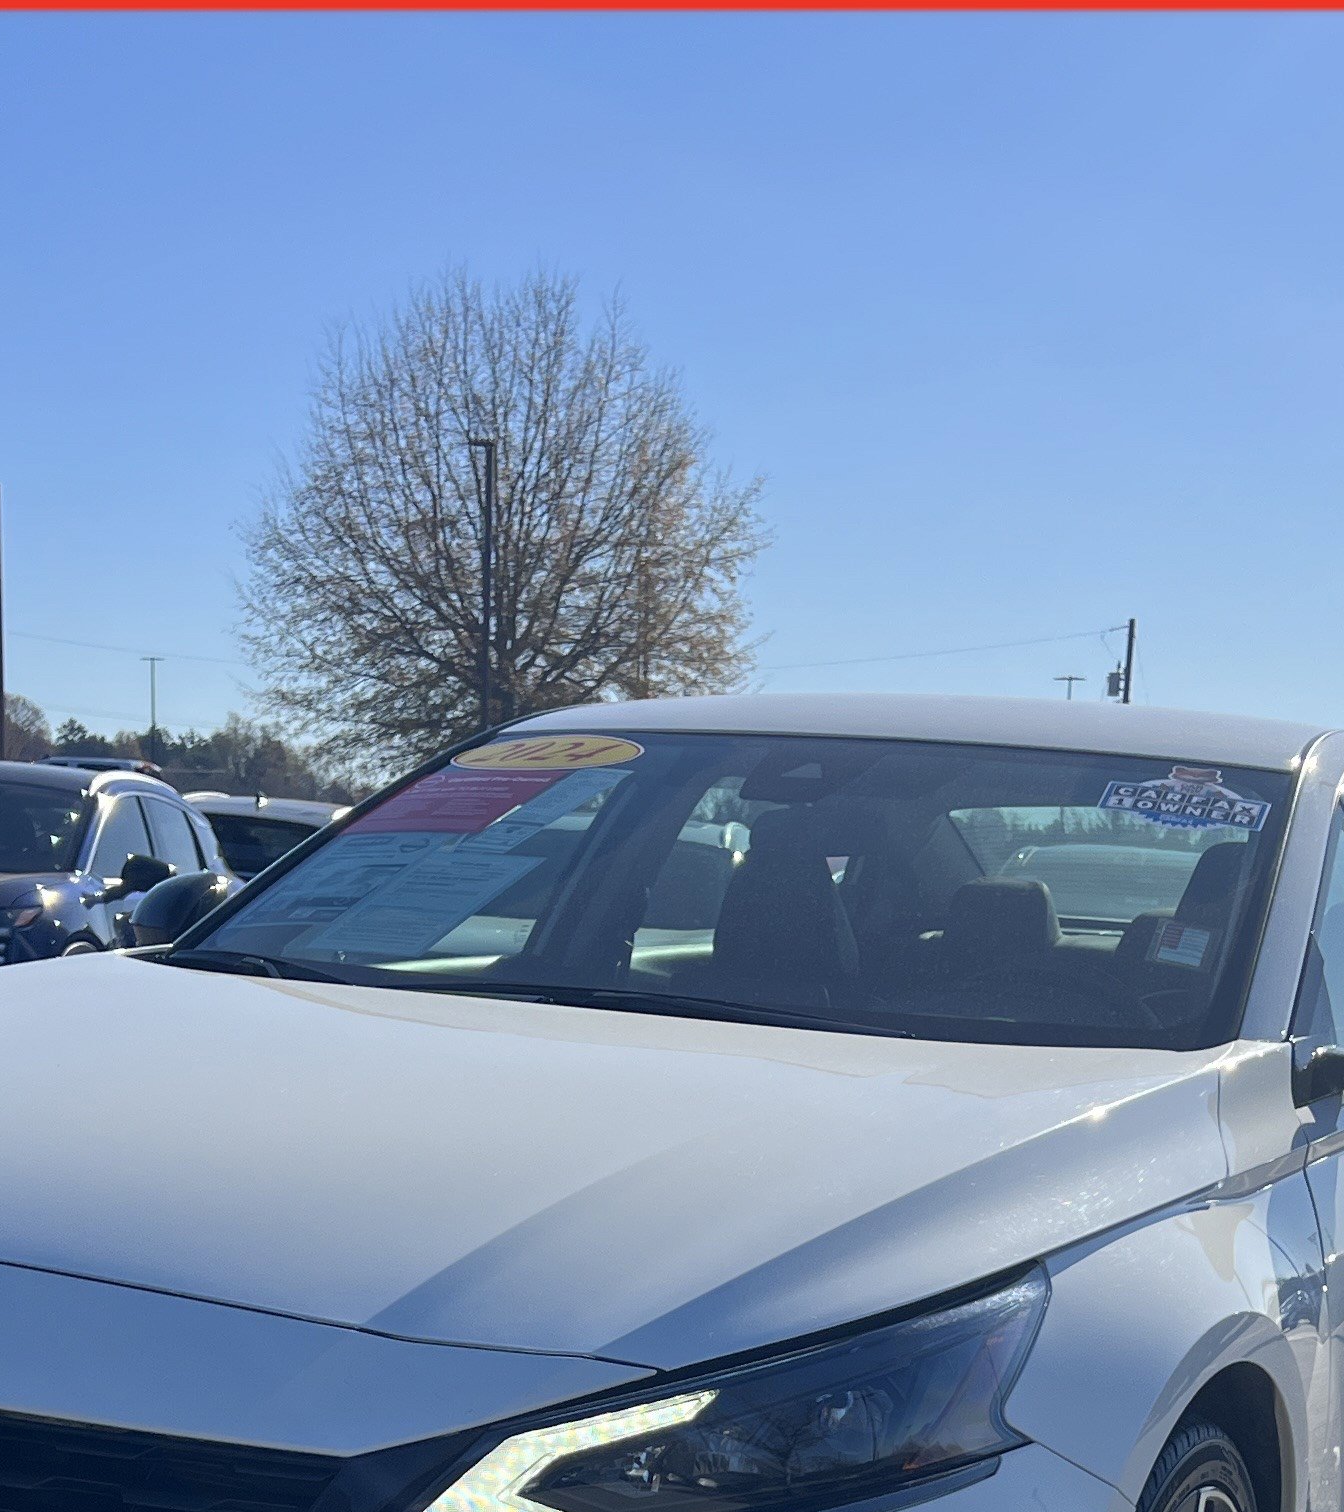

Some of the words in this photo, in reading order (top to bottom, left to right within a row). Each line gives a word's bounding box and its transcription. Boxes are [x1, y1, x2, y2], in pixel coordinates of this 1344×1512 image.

[466, 741, 625, 762] 2024
[1118, 786, 1260, 815] CARFAX
[1137, 800, 1250, 824] OWNER
